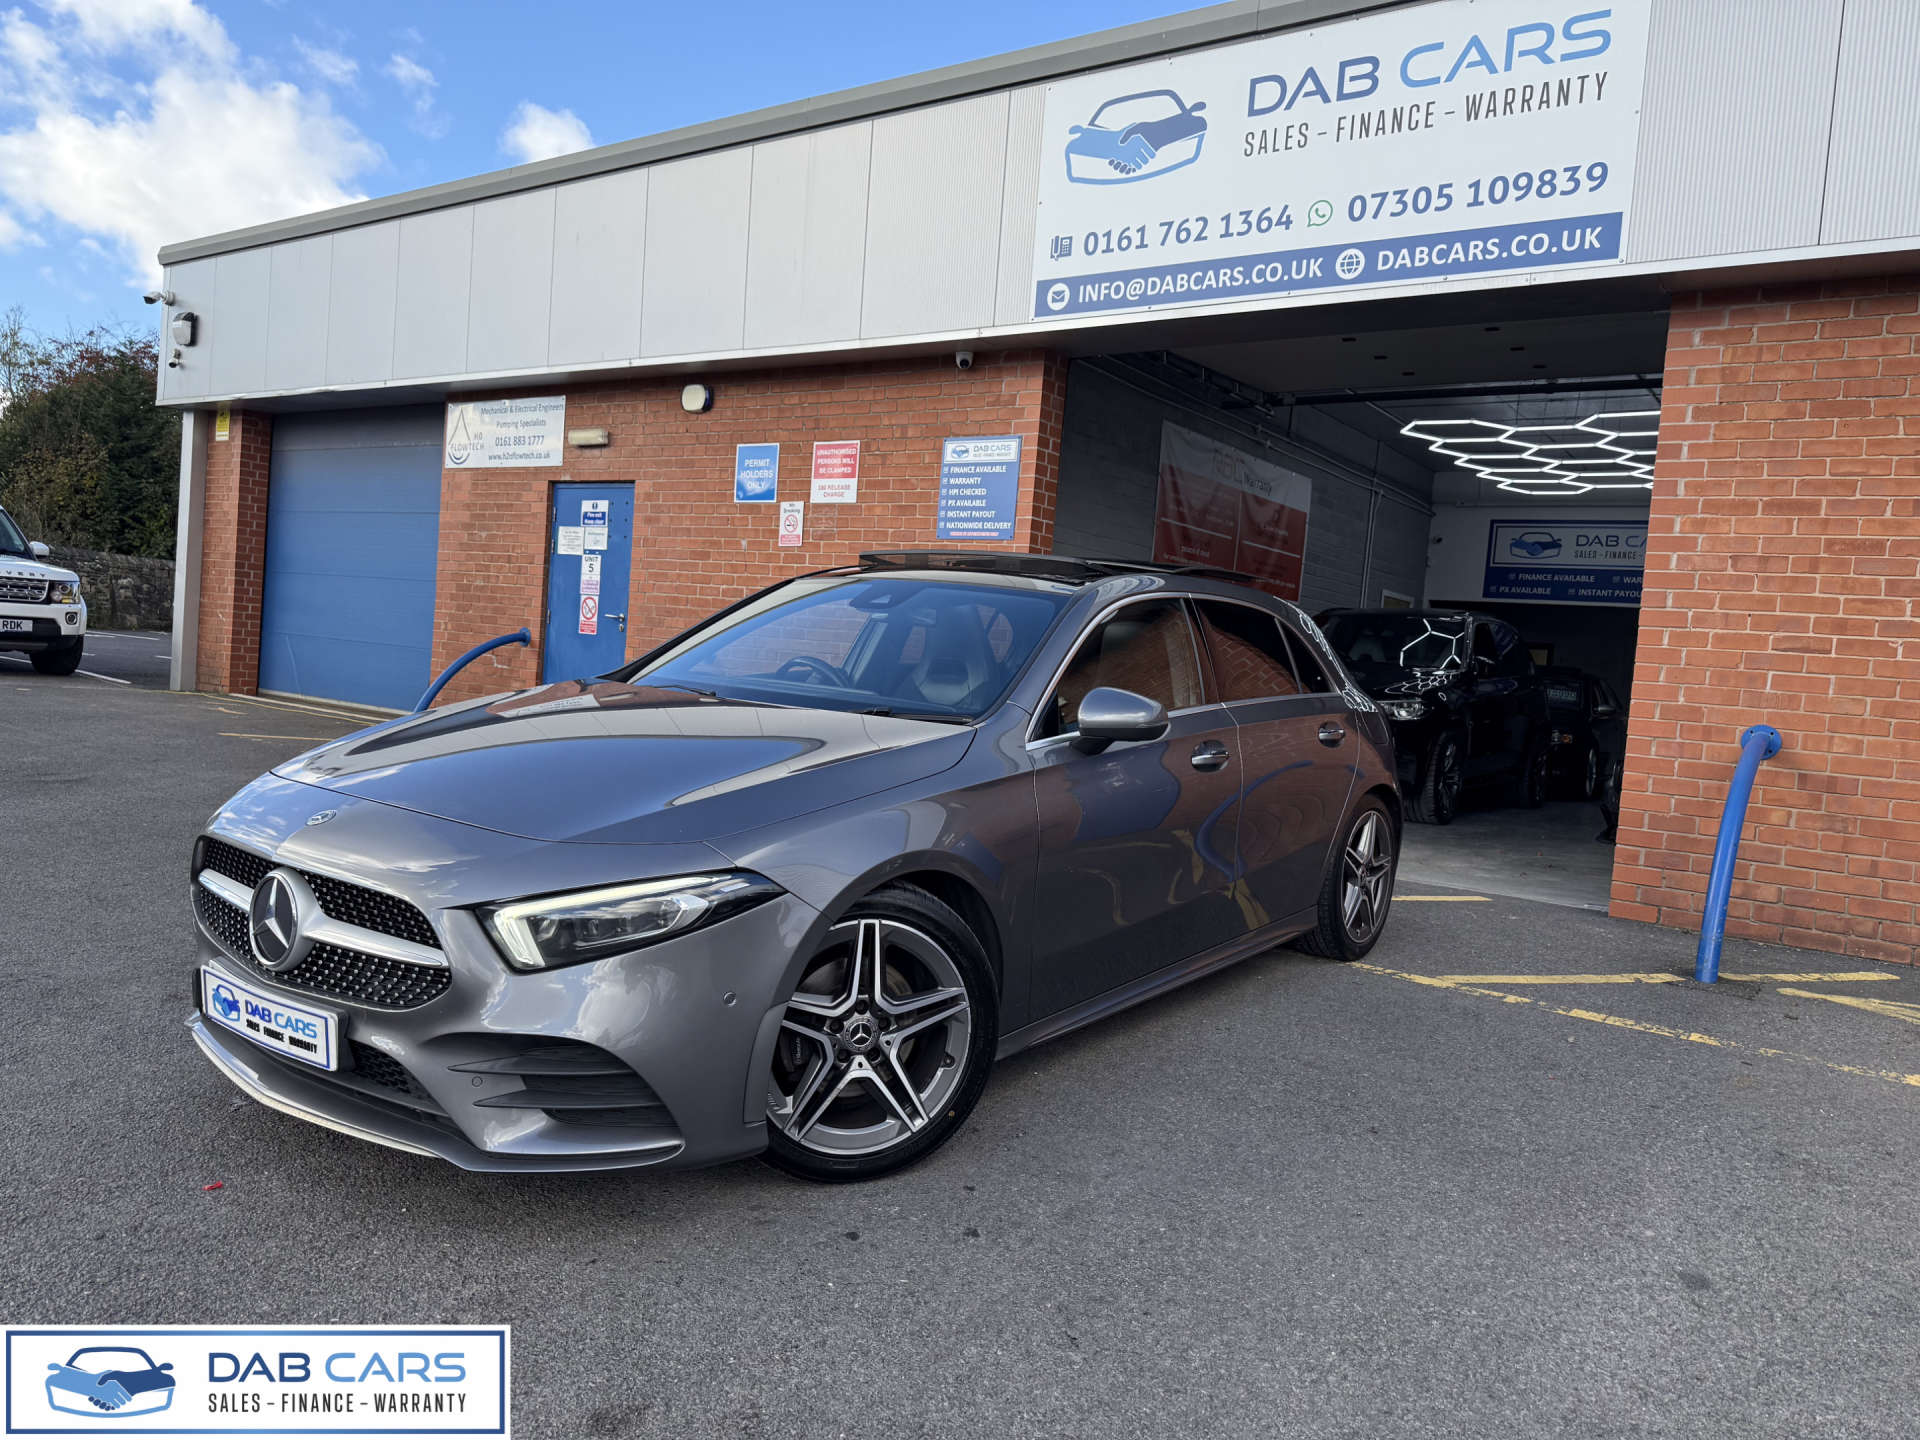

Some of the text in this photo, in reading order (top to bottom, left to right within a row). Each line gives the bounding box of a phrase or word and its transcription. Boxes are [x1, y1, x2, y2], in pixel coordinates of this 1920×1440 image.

[1248, 8, 1612, 118] DAB CARS
[1243, 122, 1309, 157] SALES
[1336, 101, 1436, 143] FINANCE
[1464, 71, 1609, 123] WARRANTY
[1347, 161, 1609, 223] 07305 109839
[1083, 204, 1294, 257] 0161 762 1364
[1376, 226, 1602, 272] DABCARS.CO.UK
[1078, 256, 1324, 305] INFO@DABCARS.CO.UK
[480, 405, 508, 416] Mechanical
[514, 404, 537, 414] Electrical
[538, 402, 564, 413] Engineers
[496, 419, 546, 430] Pumping Specialists
[495, 436, 511, 447] 0161
[528, 435, 545, 446] 1777
[973, 445, 990, 453] DAB
[744, 458, 770, 468] PERMIT
[740, 469, 774, 479] HOLDERS
[950, 465, 1007, 474] FINANCE AVAILABLE
[747, 480, 766, 490] ONLY
[949, 477, 982, 485] WARRANTY
[948, 488, 987, 496] HPI CHECKED
[946, 510, 996, 518] INSTANT PAYOUT
[1575, 534, 1620, 548] DAB
[1605, 550, 1637, 560] FINANCE
[588, 563, 594, 573] 5
[1518, 573, 1596, 583] FINANCE AVAILABLE
[1511, 586, 1551, 595] AVAILABLE
[1578, 588, 1612, 596] INSTANT
[2, 620, 23, 630] RDK
[245, 1000, 317, 1039] DAB CARS
